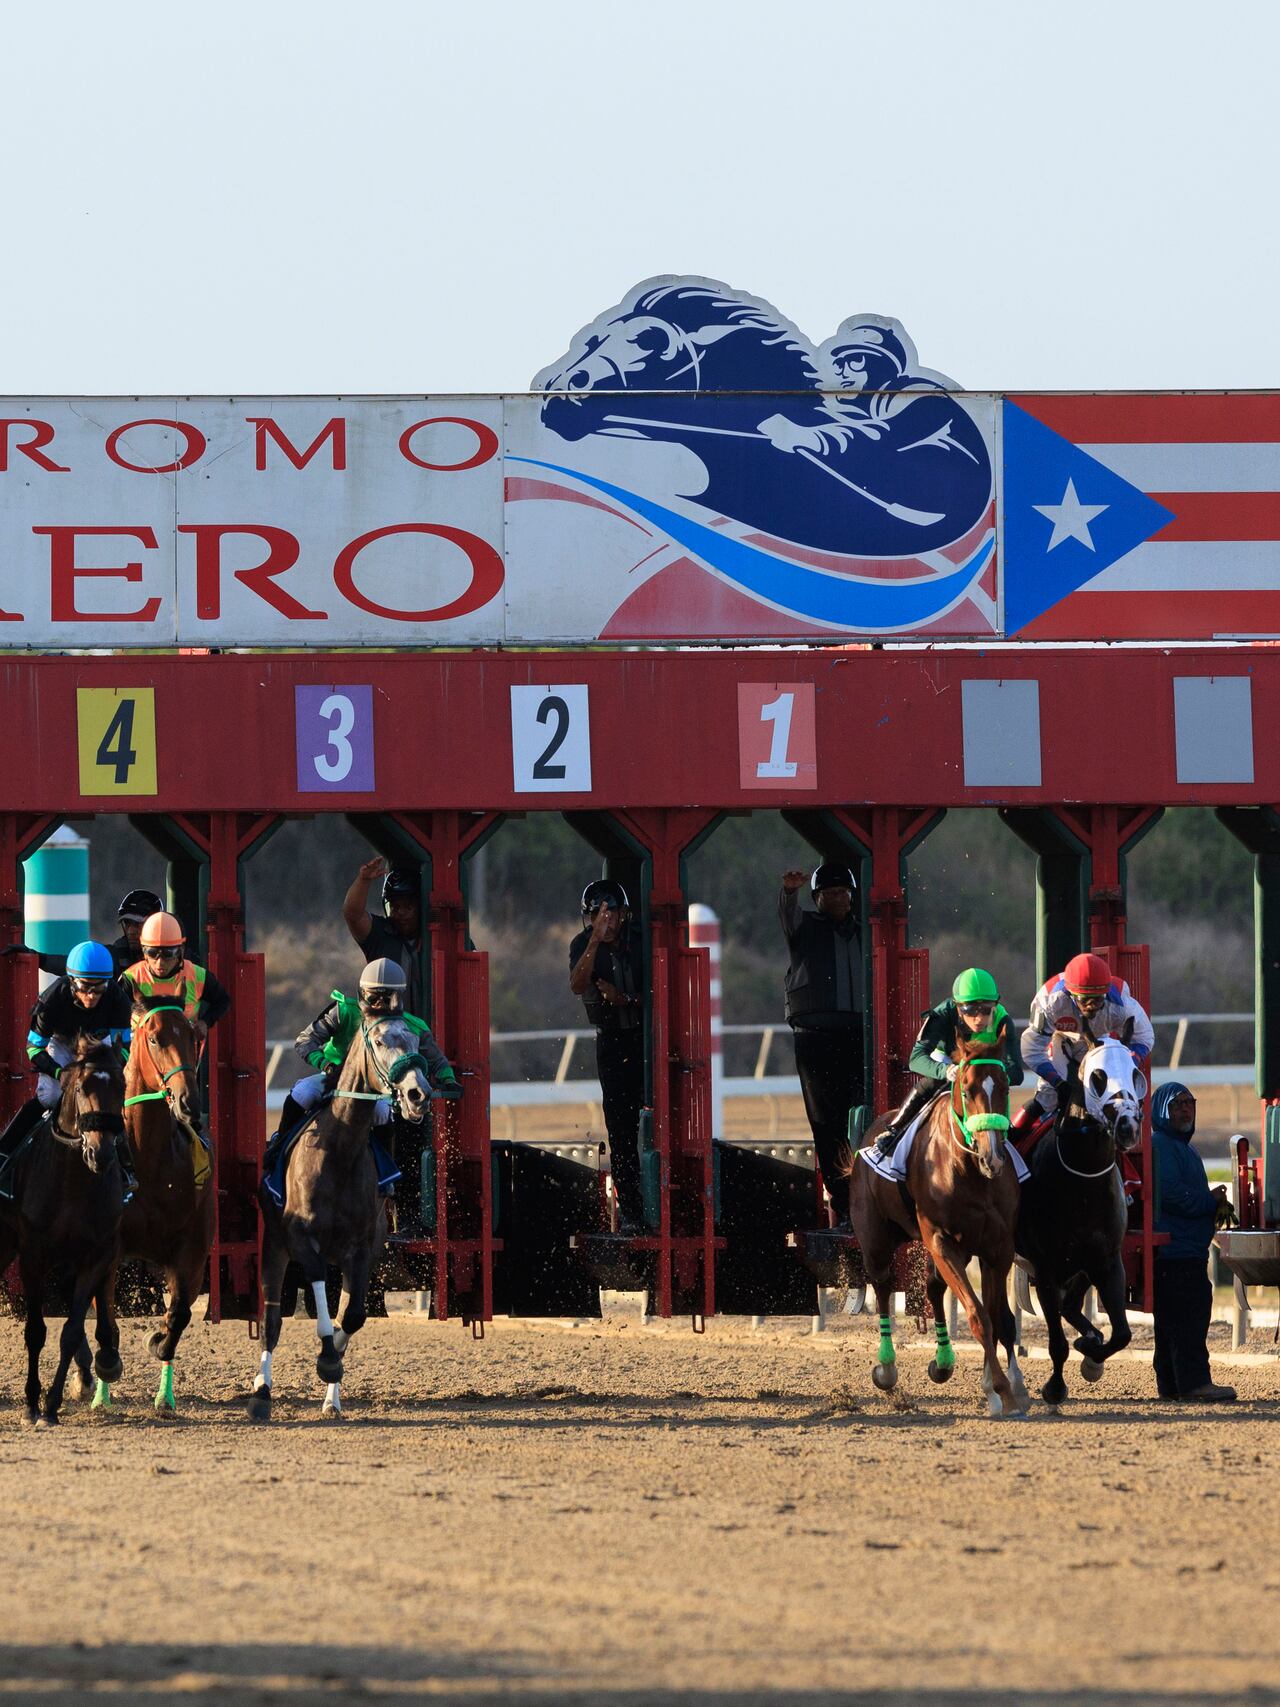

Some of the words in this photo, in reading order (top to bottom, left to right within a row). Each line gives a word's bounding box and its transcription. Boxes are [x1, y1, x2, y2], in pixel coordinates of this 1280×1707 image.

[96, 699, 136, 784] 4
[313, 694, 355, 782] 3
[532, 695, 570, 780] 2
[757, 693, 797, 778] 1
